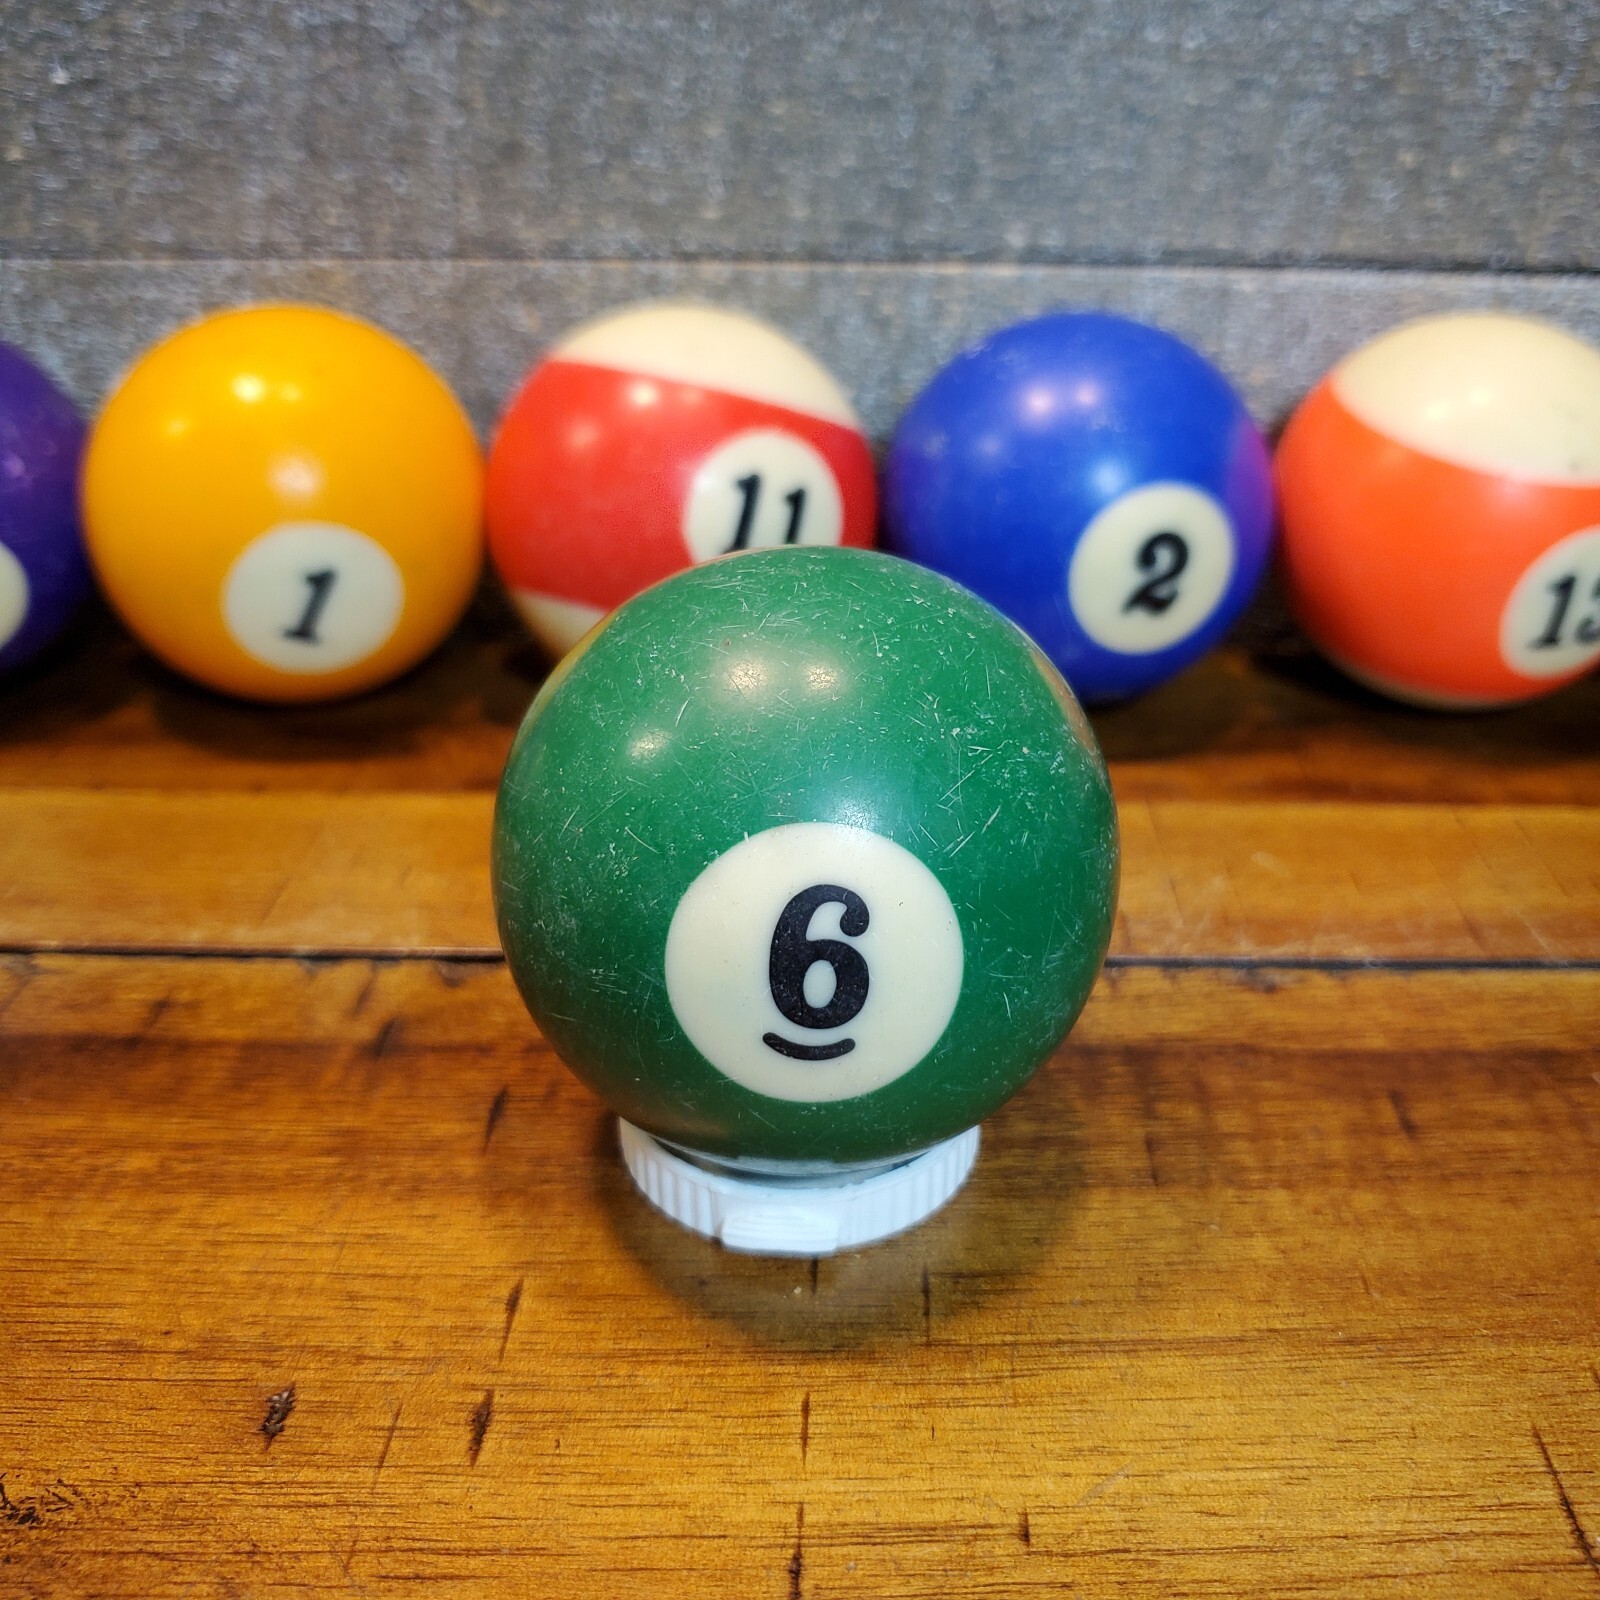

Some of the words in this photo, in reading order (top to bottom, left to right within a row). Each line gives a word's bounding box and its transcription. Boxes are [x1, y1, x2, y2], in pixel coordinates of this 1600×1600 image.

[724, 473, 807, 553] 11
[282, 566, 337, 645] 1
[1121, 530, 1190, 617] 2
[768, 883, 871, 1030] 6
